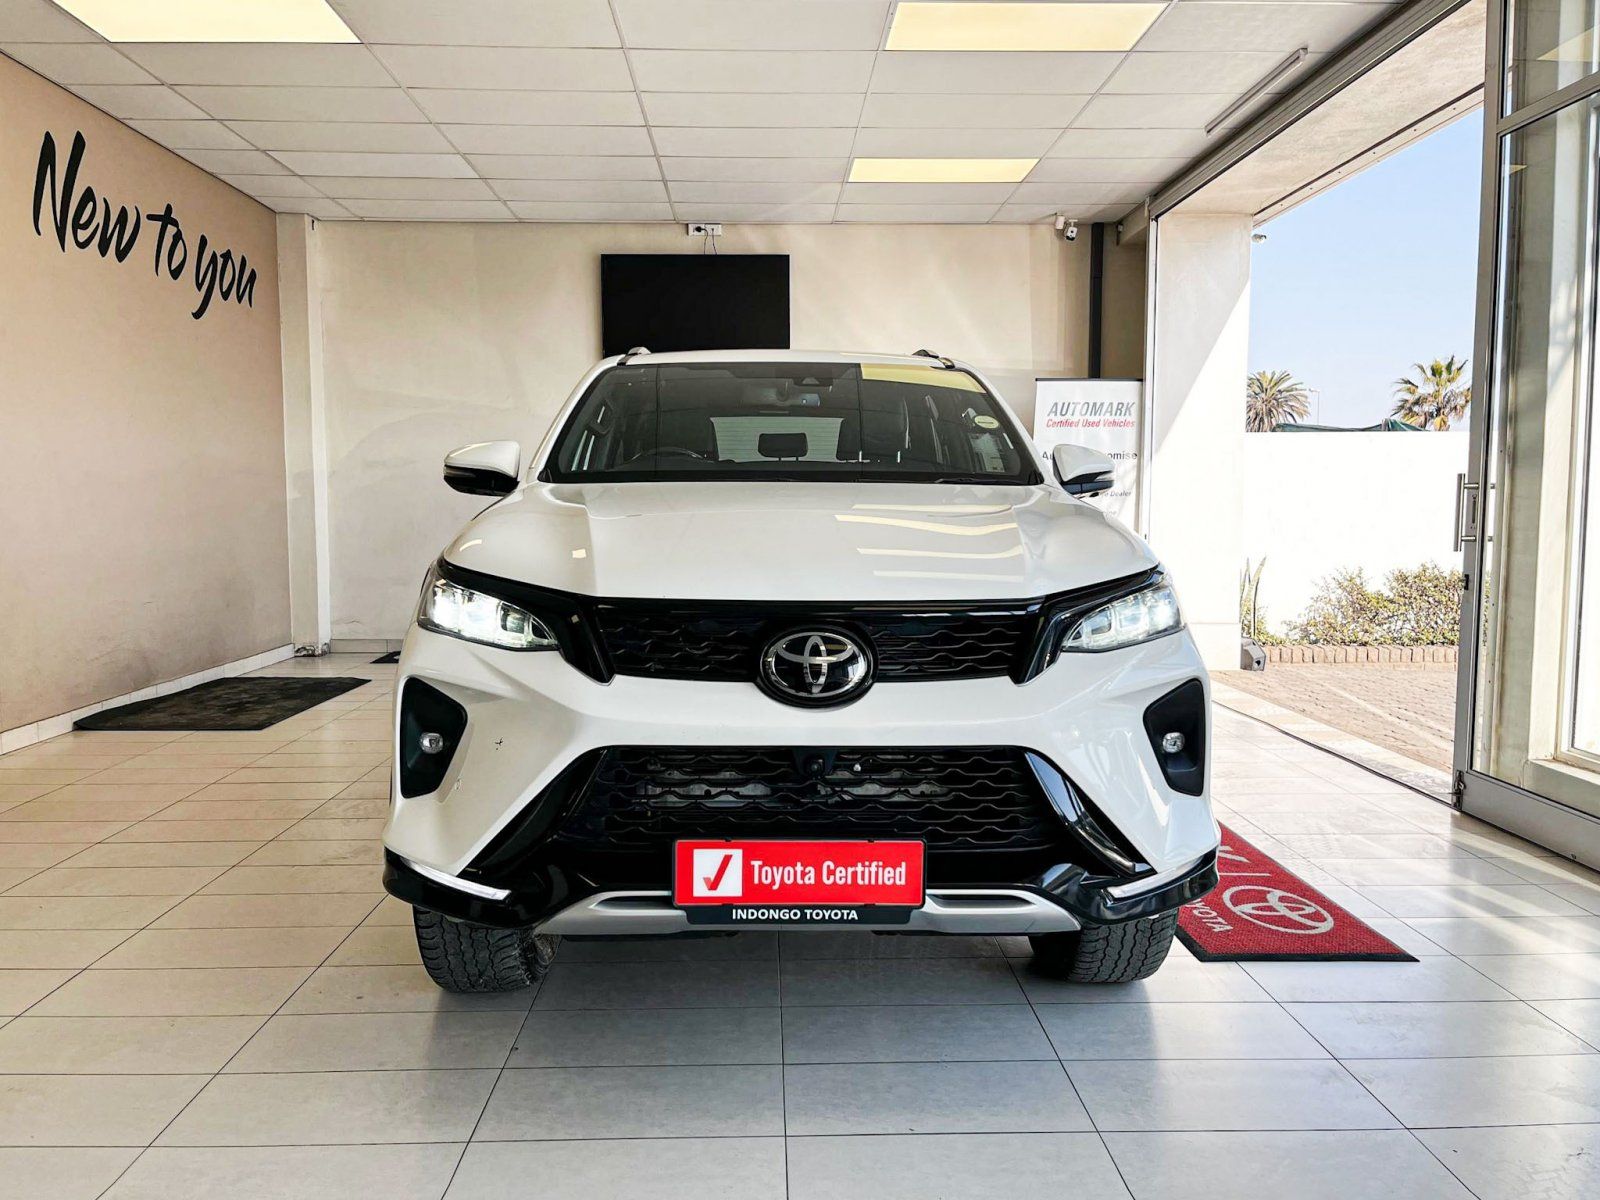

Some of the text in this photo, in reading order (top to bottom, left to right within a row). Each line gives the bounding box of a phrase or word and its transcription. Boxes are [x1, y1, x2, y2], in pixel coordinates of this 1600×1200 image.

[33, 130, 257, 320] New to you
[1047, 402, 1136, 417] AUTOMARK
[1046, 418, 1136, 428] Certified Used Vehicles
[751, 860, 906, 890] Toyota Certified
[732, 908, 858, 920] INDONGO TOYOTA
[1185, 898, 1234, 932] YOTA
